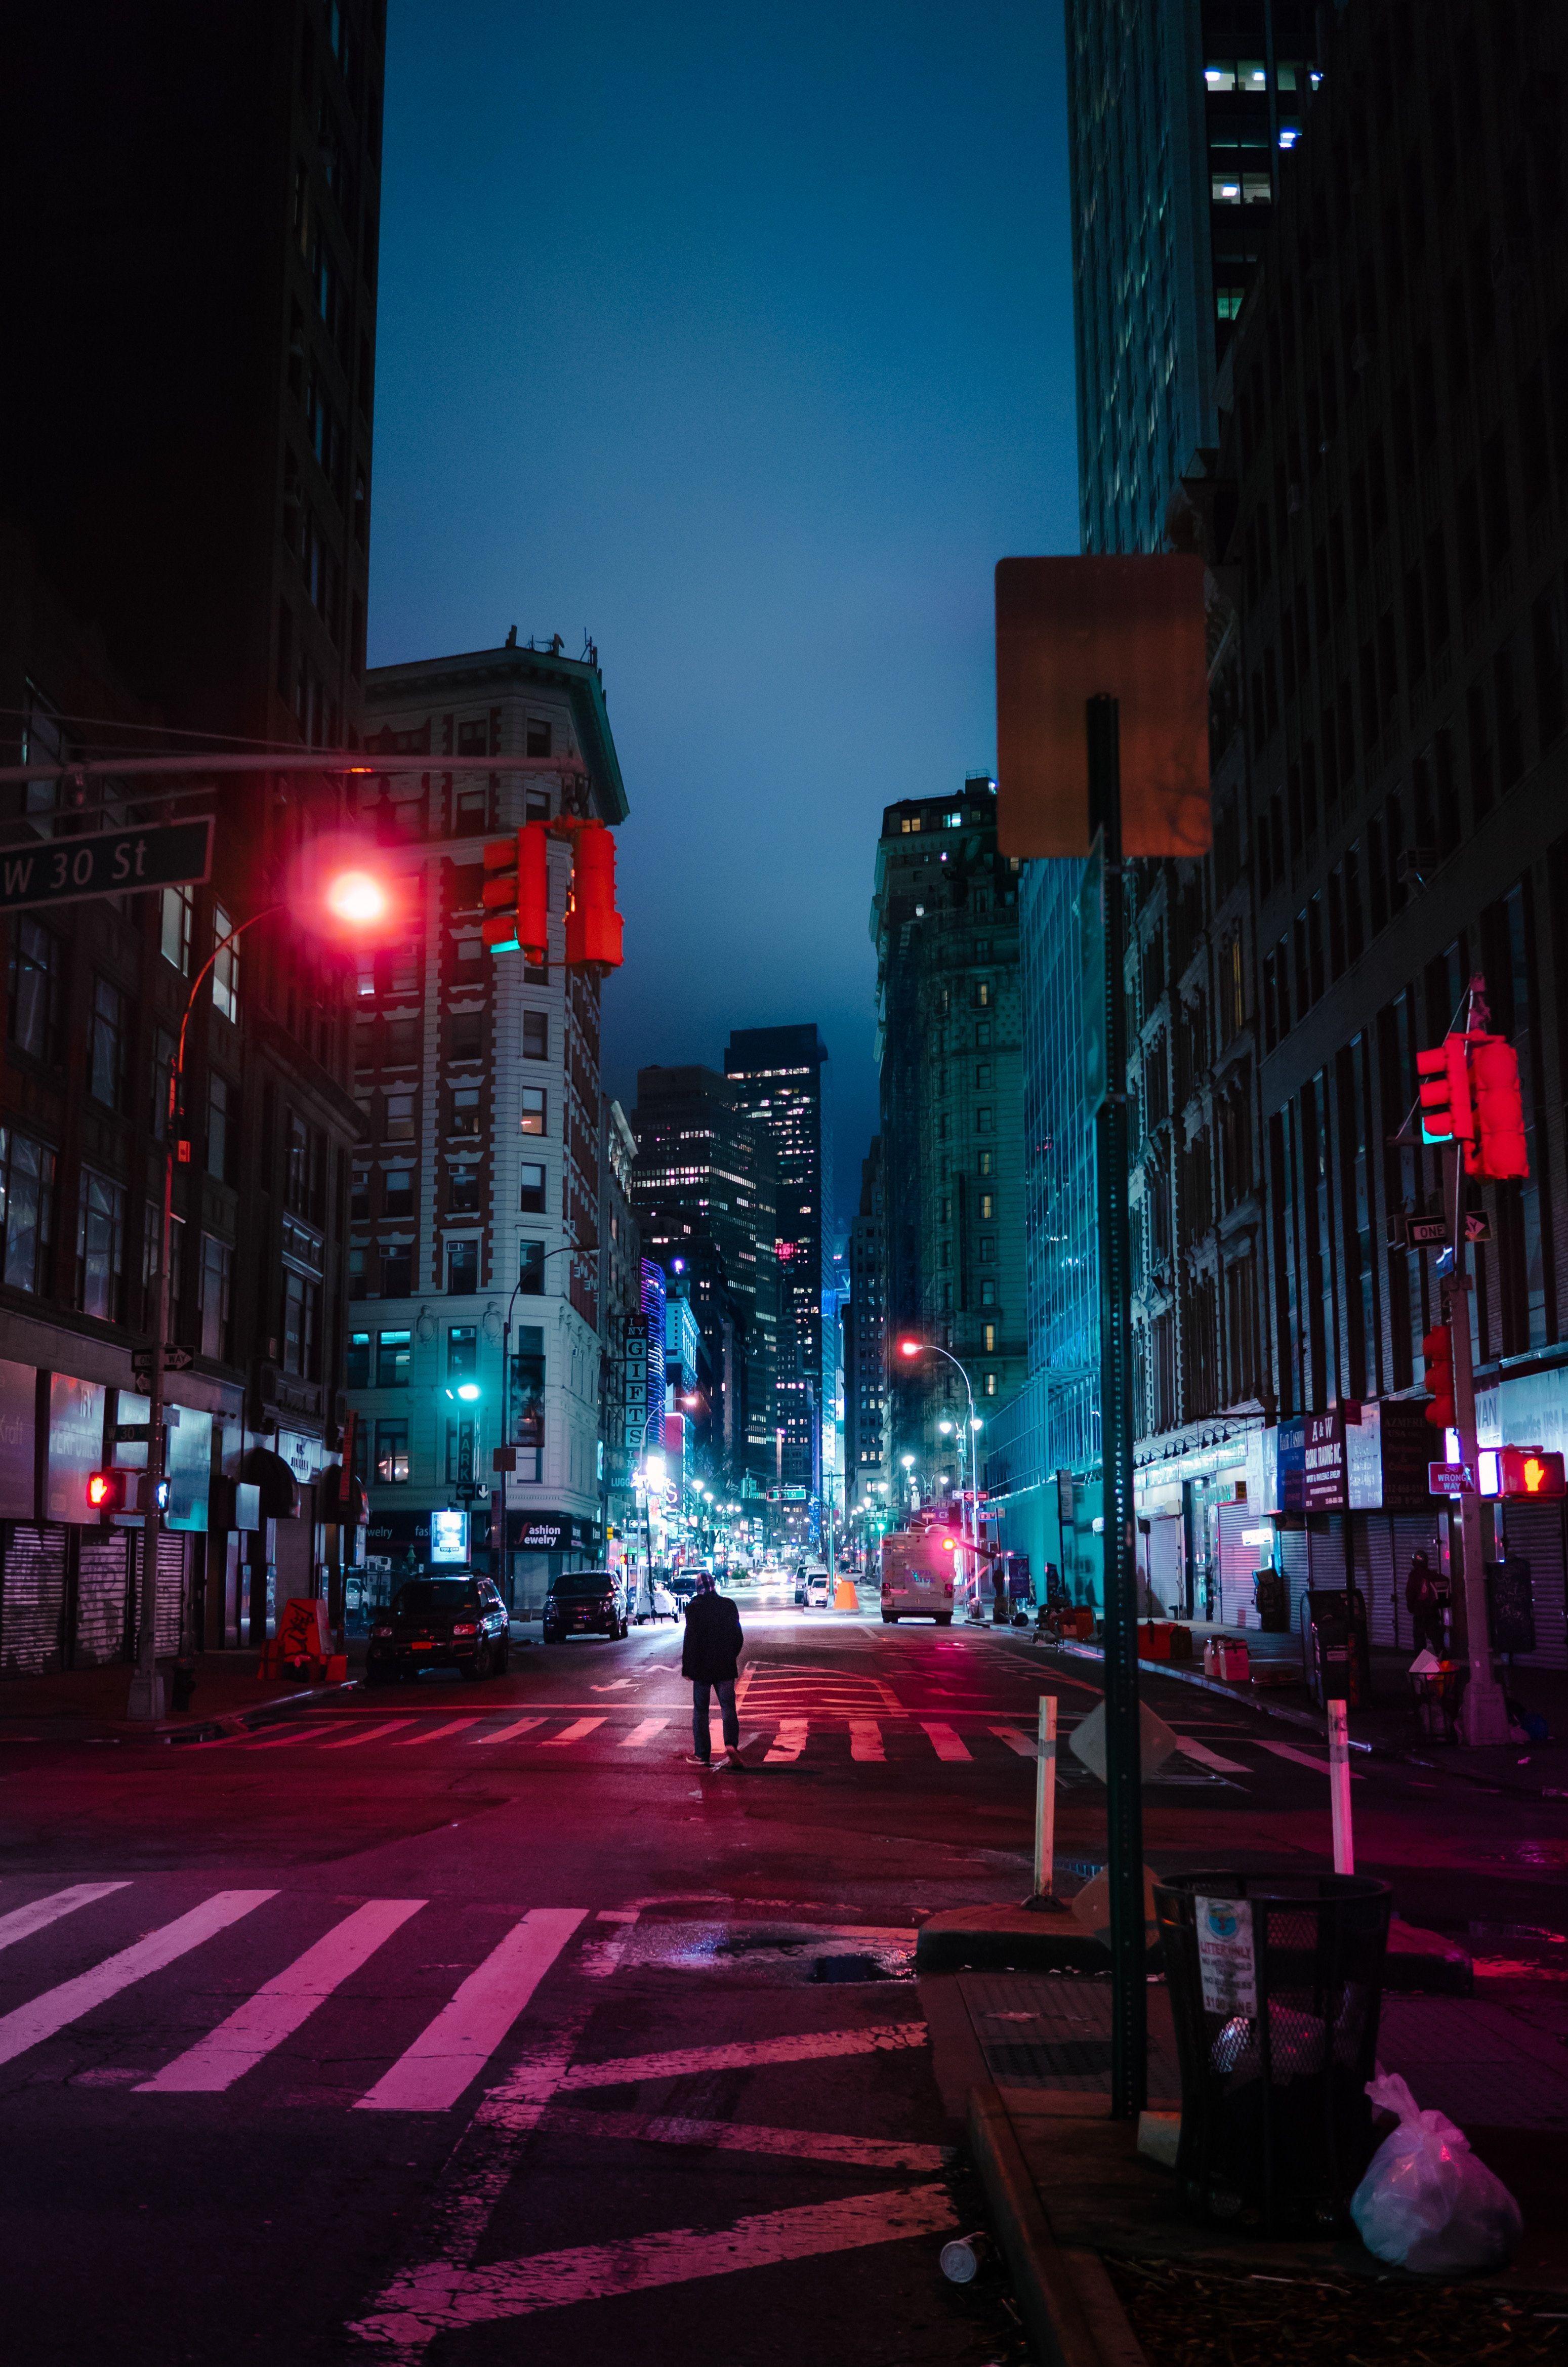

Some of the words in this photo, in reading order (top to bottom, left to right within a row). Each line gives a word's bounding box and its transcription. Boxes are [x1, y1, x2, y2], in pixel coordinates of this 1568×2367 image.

[4, 857, 34, 896] W
[50, 848, 94, 889] 30
[111, 839, 147, 880] St
[1420, 1225, 1443, 1238] ONE
[627, 1326, 645, 1335] NY
[140, 1356, 152, 1365] ON
[169, 1355, 185, 1363] WAY
[628, 1341, 644, 1443] GIFTS
[107, 1426, 117, 1440] W
[120, 1426, 135, 1440] 30
[1325, 1416, 1333, 1439] W
[461, 1424, 470, 1481] PARK
[611, 1477, 631, 1487] LUGG
[1437, 1474, 1467, 1482] WRONG
[1443, 1482, 1461, 1490] WAY
[366, 1526, 393, 1539] welry
